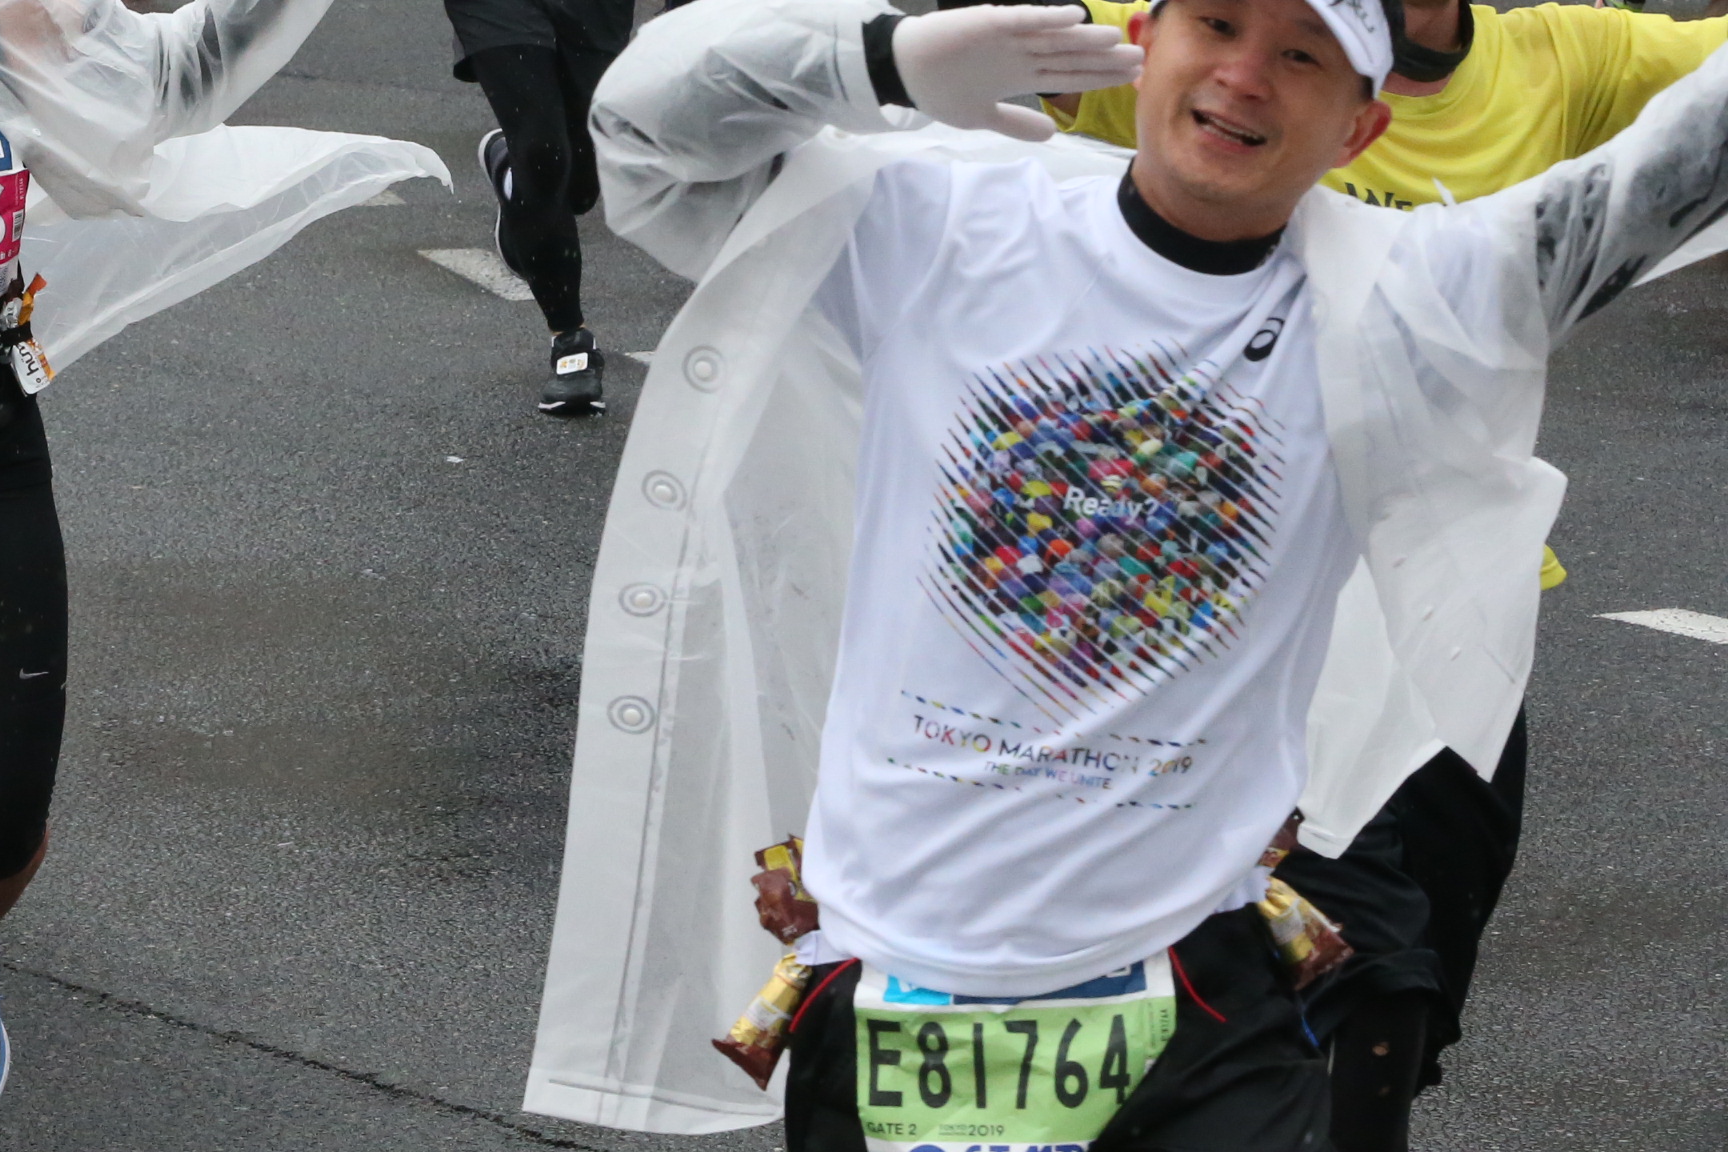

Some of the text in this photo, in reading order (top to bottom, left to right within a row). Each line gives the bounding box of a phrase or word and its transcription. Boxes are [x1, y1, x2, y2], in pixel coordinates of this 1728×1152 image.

[1063, 485, 1160, 526] Ready?
[914, 714, 992, 753] TOKYO
[1148, 755, 1194, 778] 2019
[984, 760, 1010, 776] THE
[1044, 769, 1068, 782] WE
[867, 1013, 1132, 1110] E81764
[866, 1122, 918, 1136] GATE 2
[968, 1124, 1005, 1137] 2019
